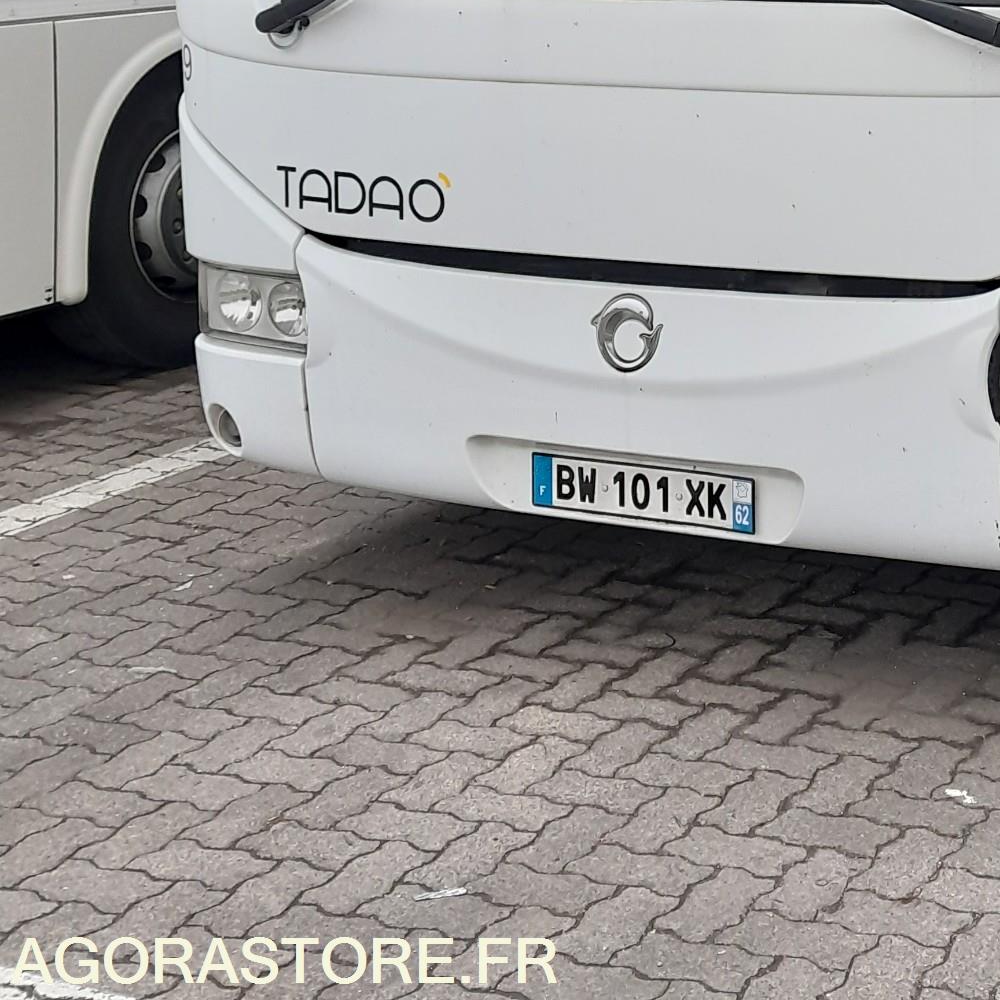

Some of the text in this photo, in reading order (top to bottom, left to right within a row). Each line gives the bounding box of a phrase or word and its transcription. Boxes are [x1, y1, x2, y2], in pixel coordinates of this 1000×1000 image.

[276, 165, 451, 223] TADAO
[539, 485, 547, 497] F
[556, 464, 727, 520] BW 101 XK
[735, 505, 750, 526] 62
